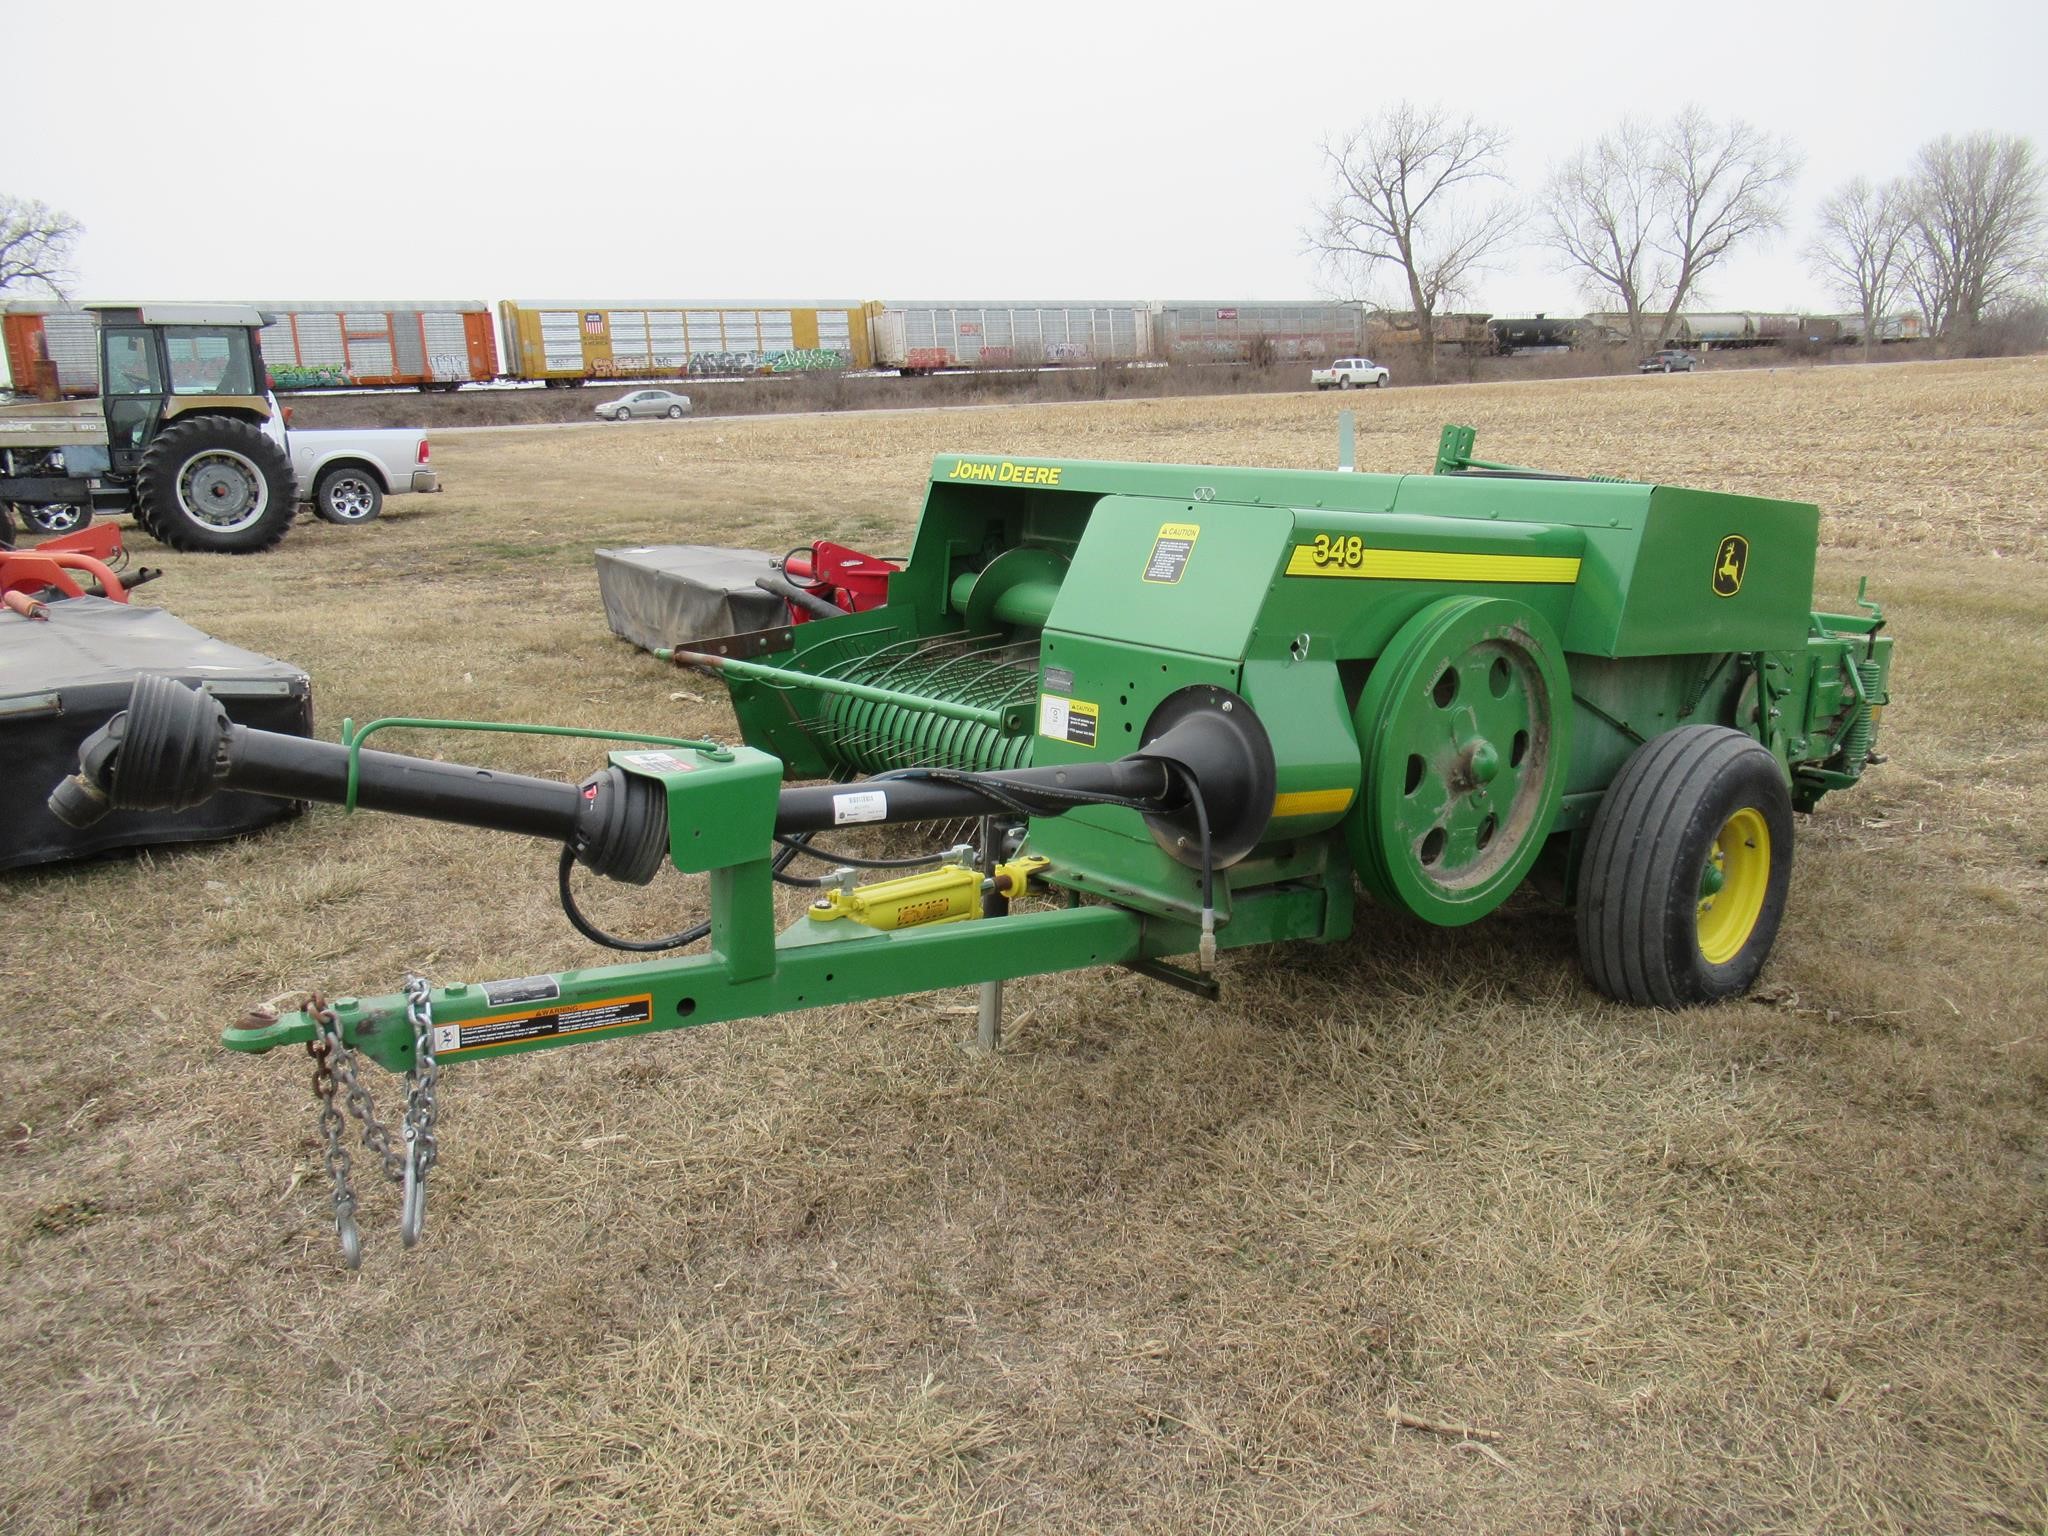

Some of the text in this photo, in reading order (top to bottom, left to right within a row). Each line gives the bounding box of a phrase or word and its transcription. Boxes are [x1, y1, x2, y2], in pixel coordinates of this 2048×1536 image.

[949, 459, 1062, 485] JOHN DEERE
[1168, 527, 1197, 537] CAUTION
[1312, 534, 1363, 567] 348
[1076, 705, 1095, 713] CAUTION
[541, 1005, 579, 1017] WARNING
